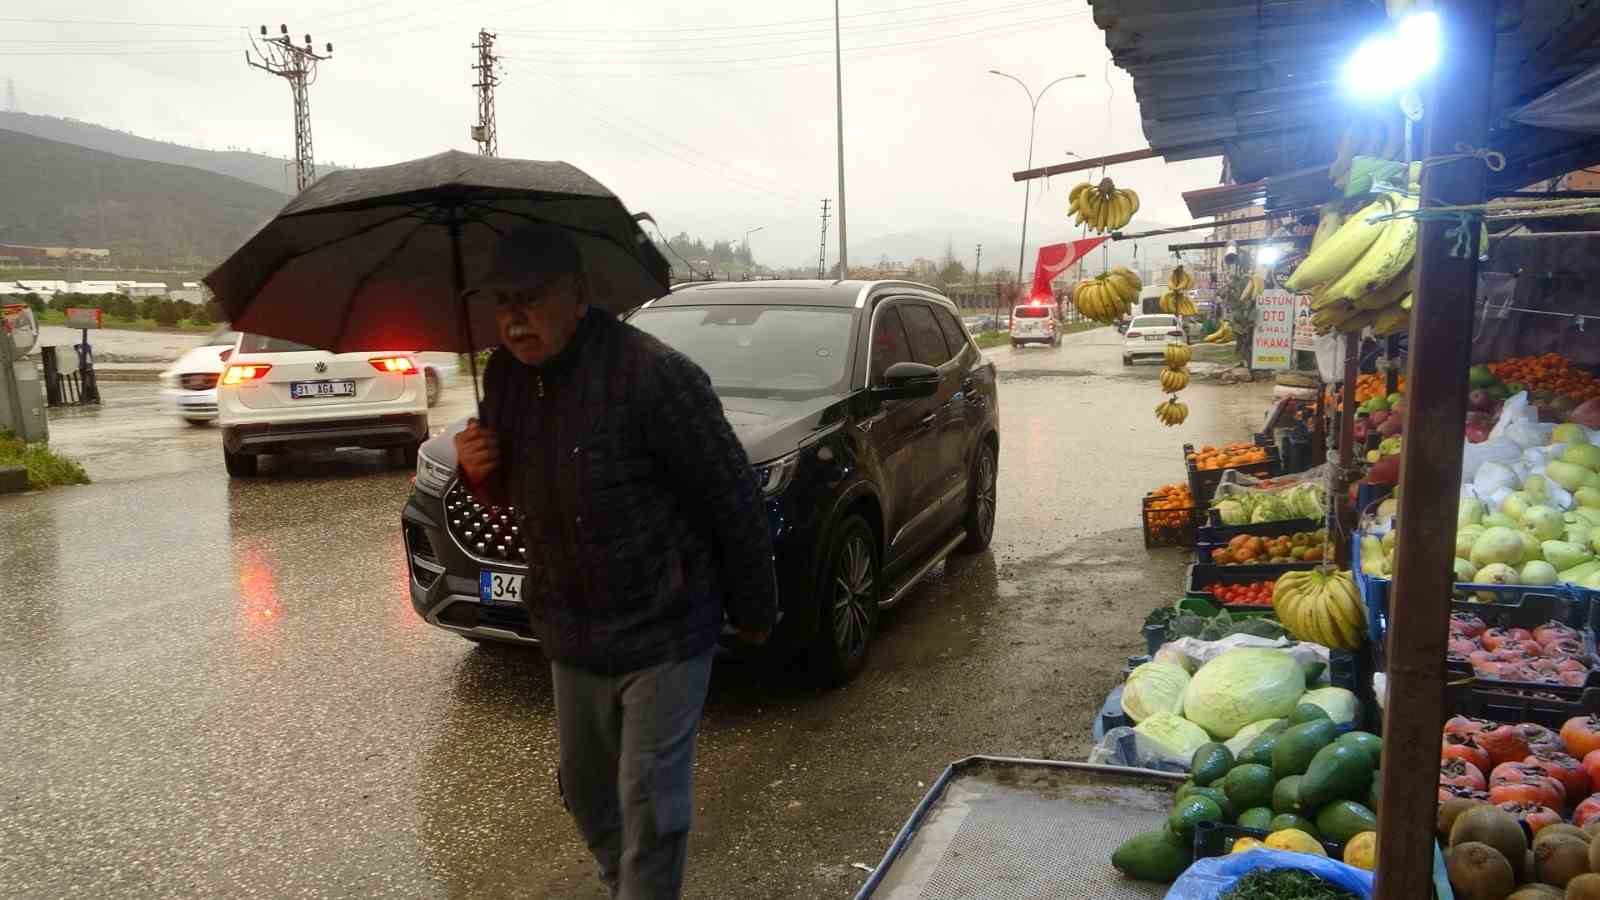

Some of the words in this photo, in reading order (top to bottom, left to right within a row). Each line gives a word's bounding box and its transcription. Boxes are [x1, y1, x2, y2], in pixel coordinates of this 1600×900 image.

[1263, 310, 1286, 322] OTO
[296, 384, 309, 395] 31
[343, 383, 354, 393] 12
[494, 575, 517, 598] 34
